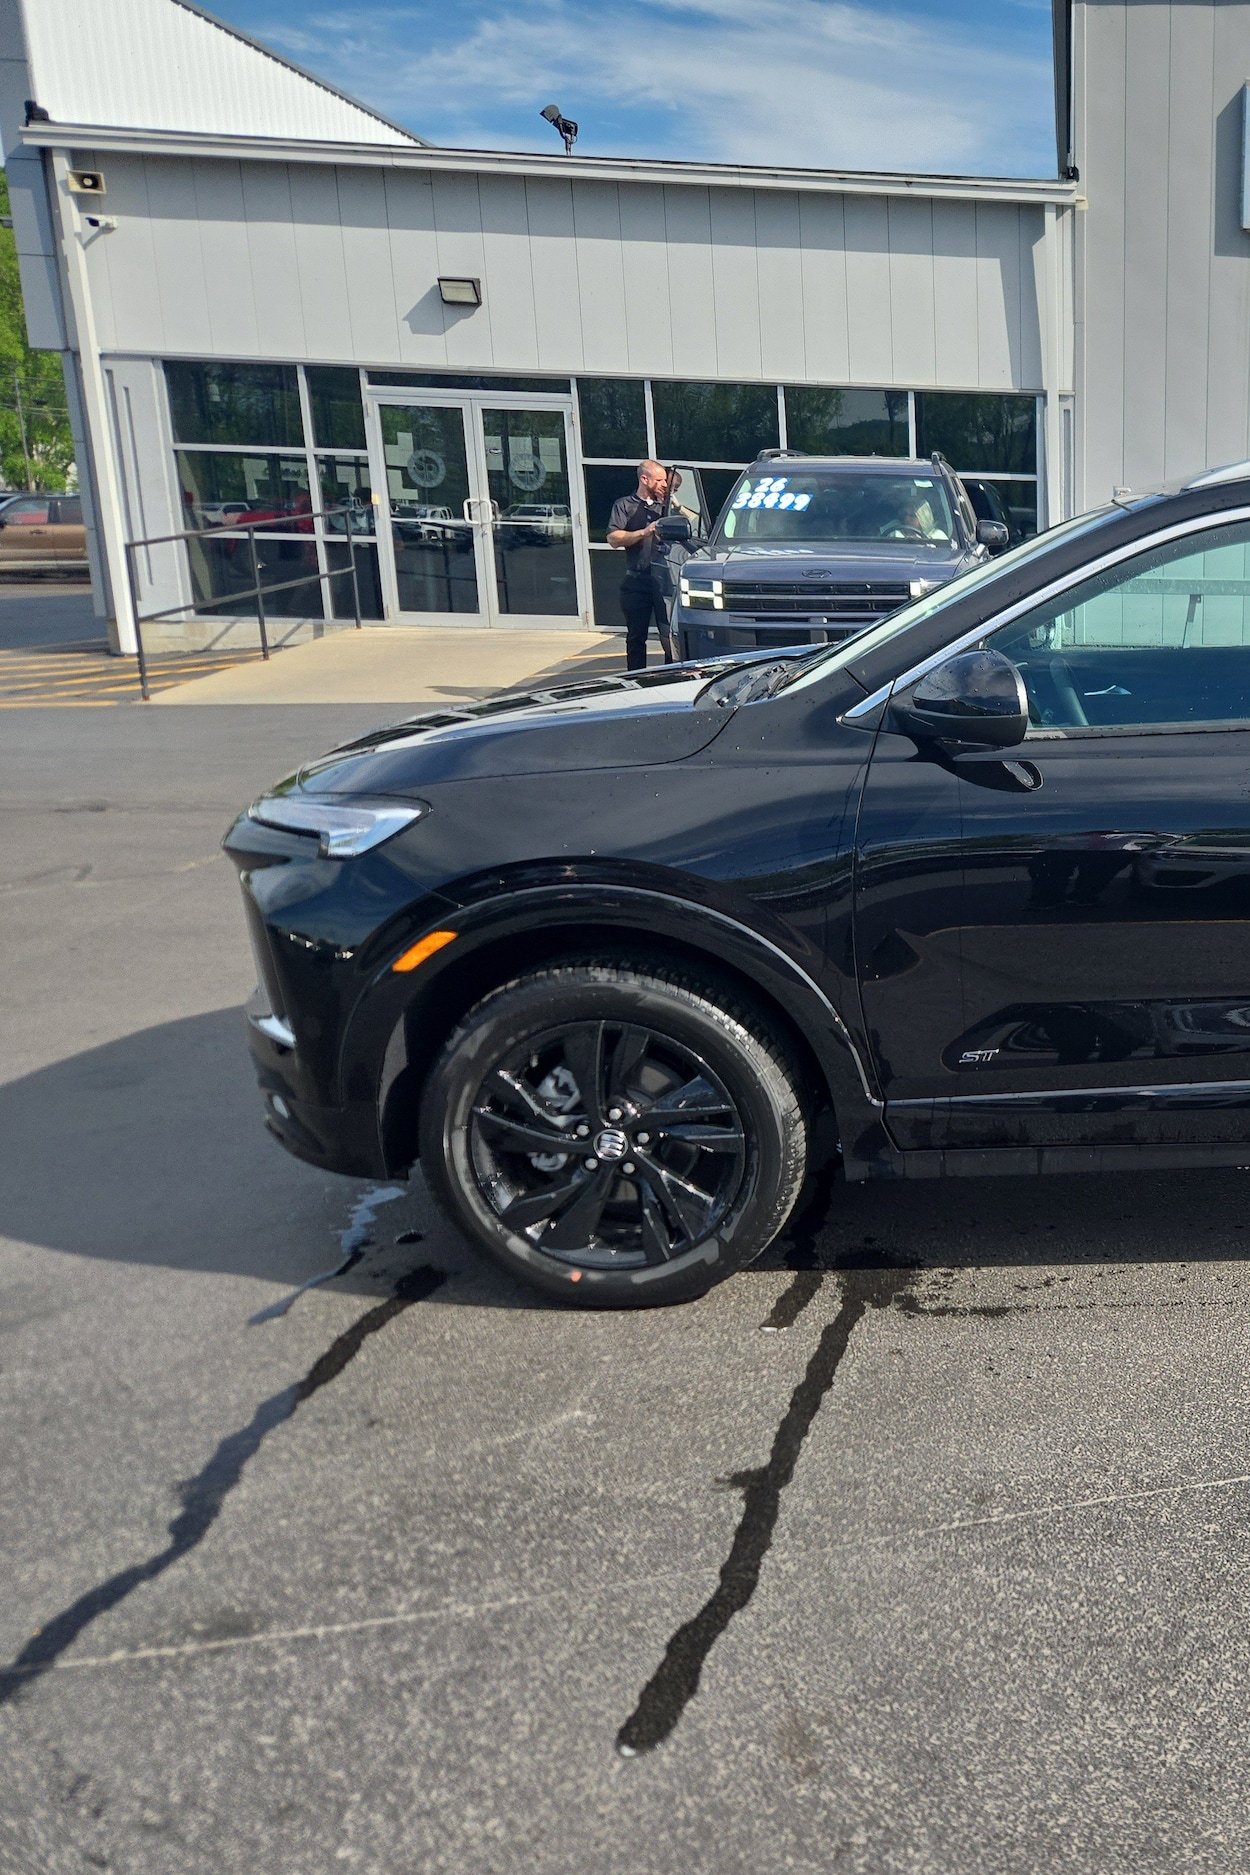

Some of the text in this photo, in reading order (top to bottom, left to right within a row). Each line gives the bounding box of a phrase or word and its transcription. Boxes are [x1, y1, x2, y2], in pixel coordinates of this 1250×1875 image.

[754, 477, 788, 492] 26
[731, 492, 810, 511] 38499
[959, 1049, 999, 1063] ST
